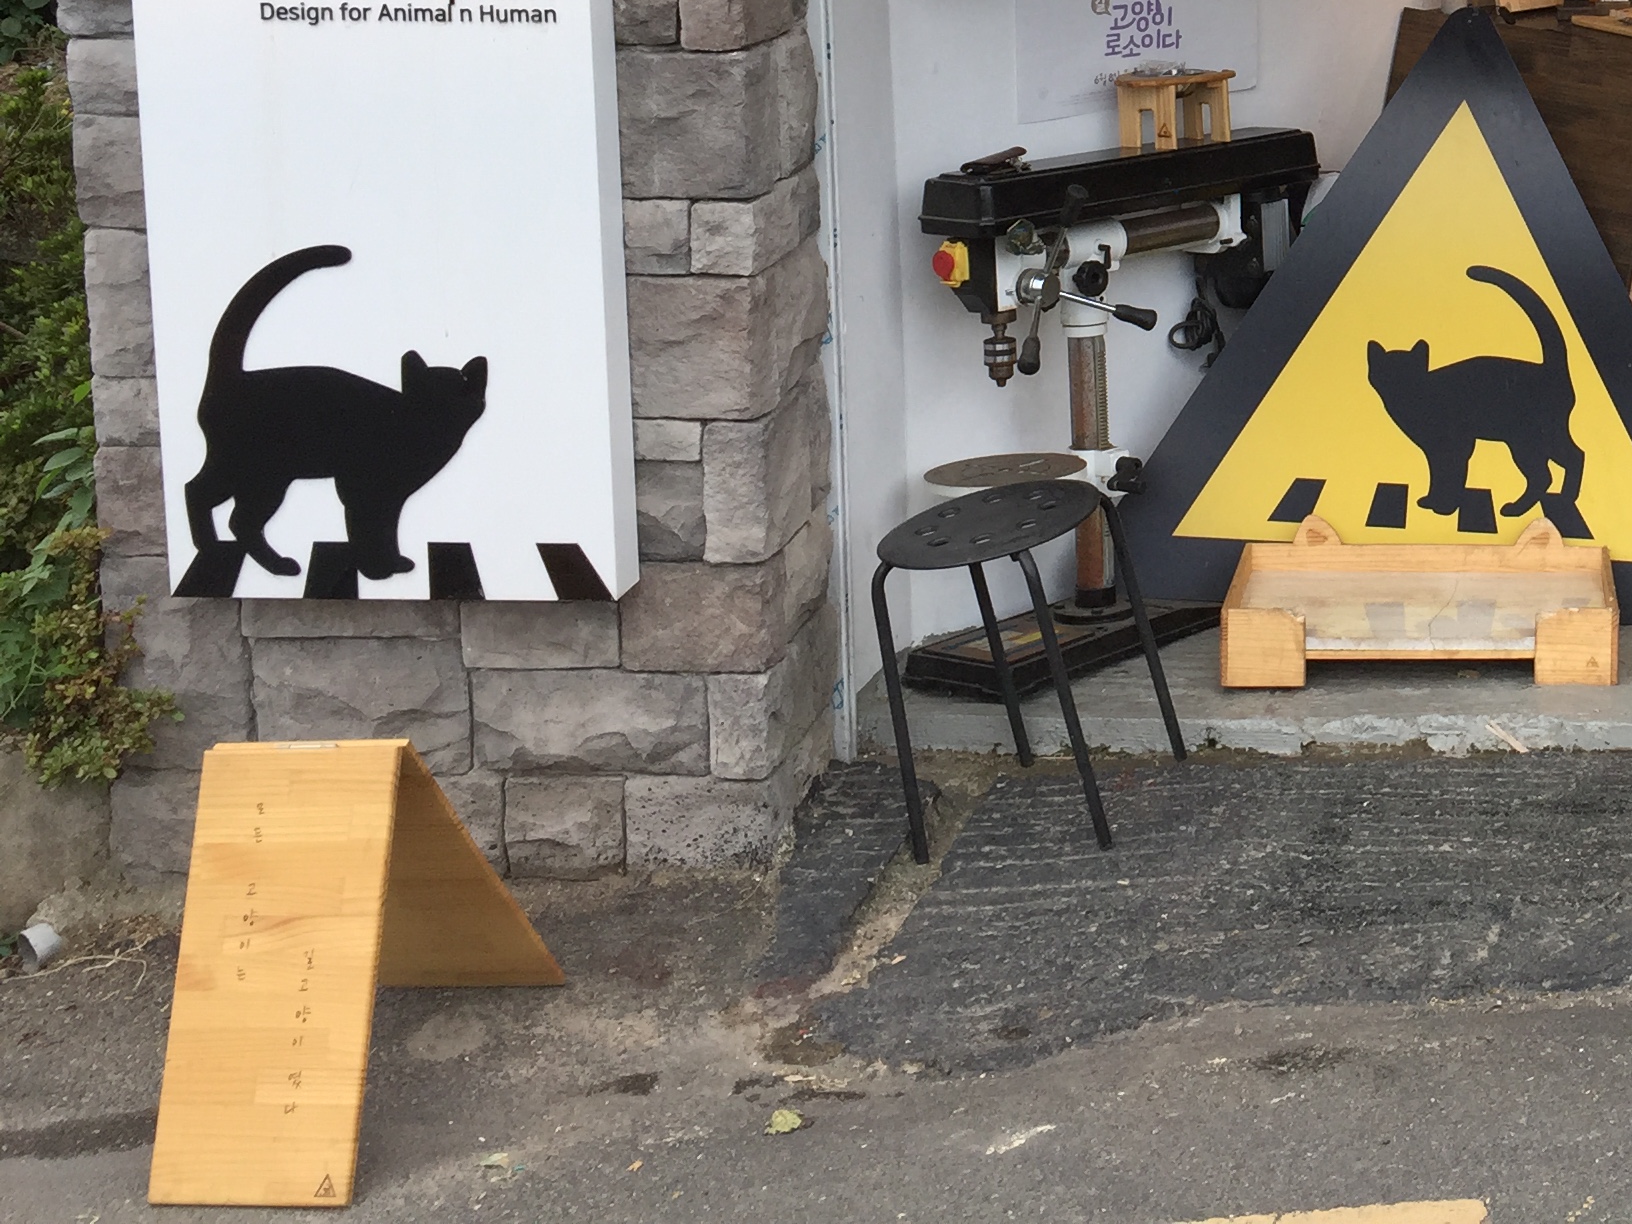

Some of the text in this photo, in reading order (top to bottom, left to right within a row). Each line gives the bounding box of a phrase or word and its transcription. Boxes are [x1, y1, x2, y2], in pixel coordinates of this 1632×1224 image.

[259, 1, 557, 26] Design for Animal n Human
[1104, 28, 1183, 59] 로소이다
